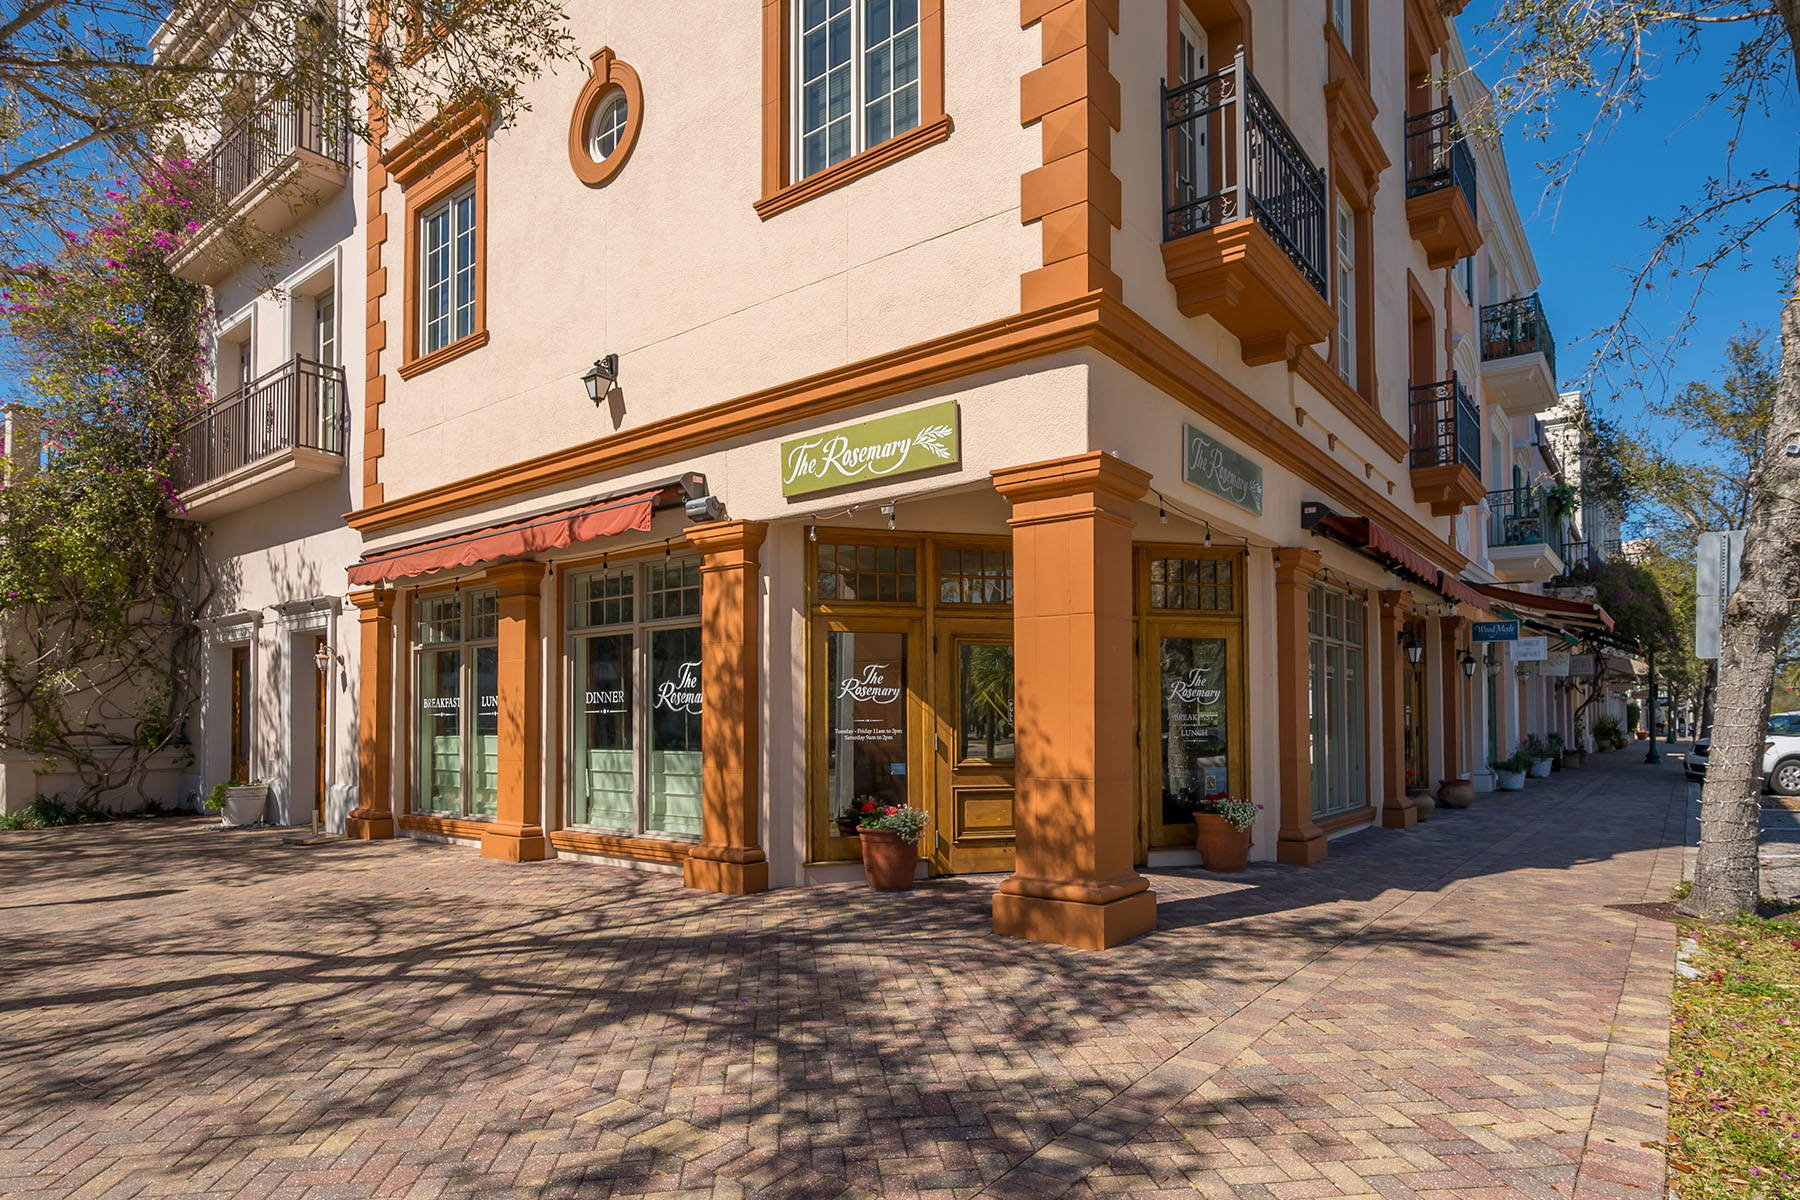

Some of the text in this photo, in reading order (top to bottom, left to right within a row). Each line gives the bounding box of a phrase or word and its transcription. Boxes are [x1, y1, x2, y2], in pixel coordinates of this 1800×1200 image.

[784, 434, 911, 484] The Rosemary
[1190, 437, 1249, 502] The Rosemary
[676, 660, 702, 689] The
[861, 664, 889, 685] The
[1188, 667, 1211, 687] The
[481, 695, 498, 707] LUN
[585, 690, 625, 704] DINNER
[653, 680, 702, 715] Rosema
[837, 677, 900, 704] Rosemary
[1166, 680, 1220, 705] Rosemary
[423, 697, 461, 708] BREAKFAST
[1174, 713, 1214, 721] BREAKFAST
